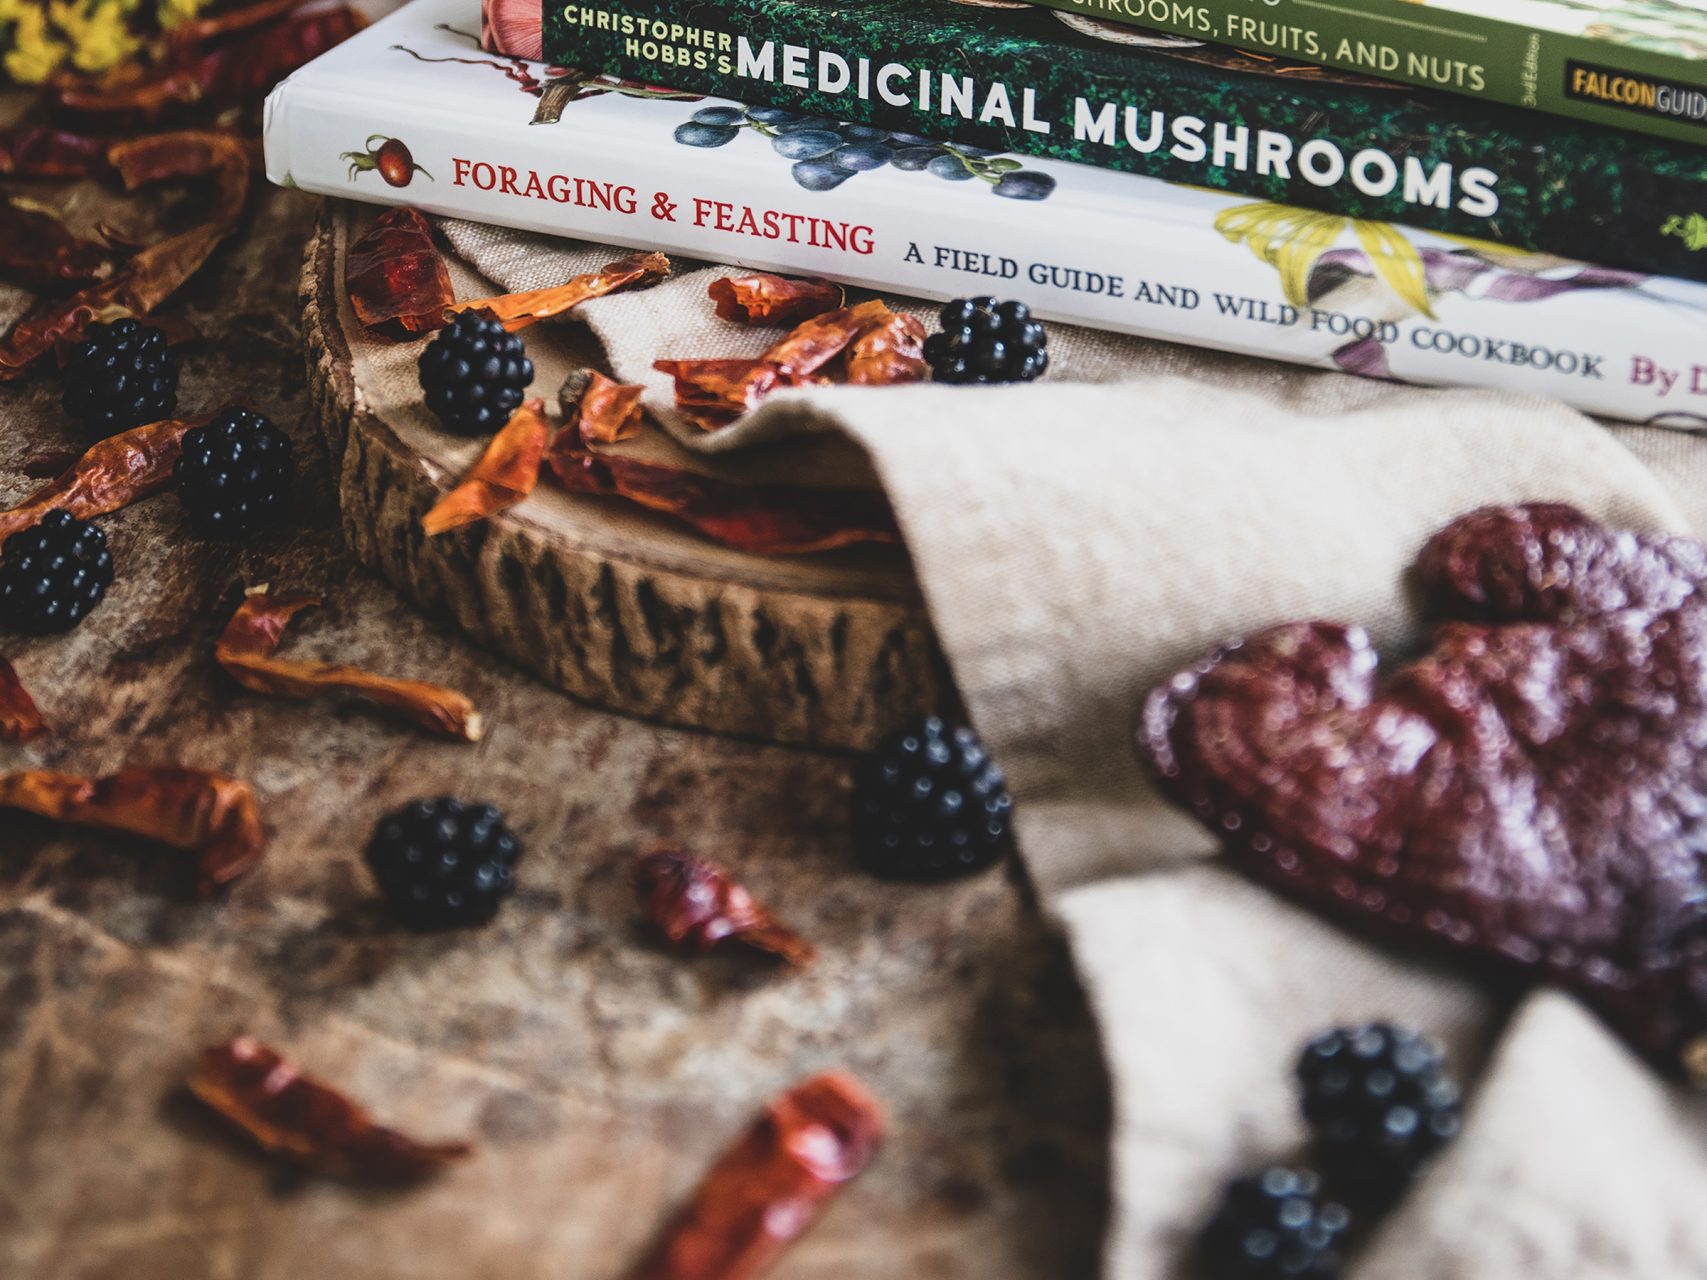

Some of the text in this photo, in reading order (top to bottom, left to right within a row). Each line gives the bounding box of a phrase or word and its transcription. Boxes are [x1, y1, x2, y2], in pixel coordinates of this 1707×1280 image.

[563, 4, 732, 53] CHRISTOPHER
[625, 37, 732, 74] HOBBS'S
[1227, 14, 1328, 61] FRUITS,
[1336, 40, 1400, 71] AND
[1407, 51, 1486, 92] NUTS
[1520, 33, 1541, 108] 3rd Edition
[1572, 68, 1707, 119] FALCONGUID
[737, 36, 1499, 218] MEDICINAL MUSHROOMS
[451, 157, 875, 256] FORAGING & FEASTING
[903, 242, 1606, 380] A FIELD GUIDE AND WILD FOOD COOKBOOK
[1629, 354, 1679, 397] By
